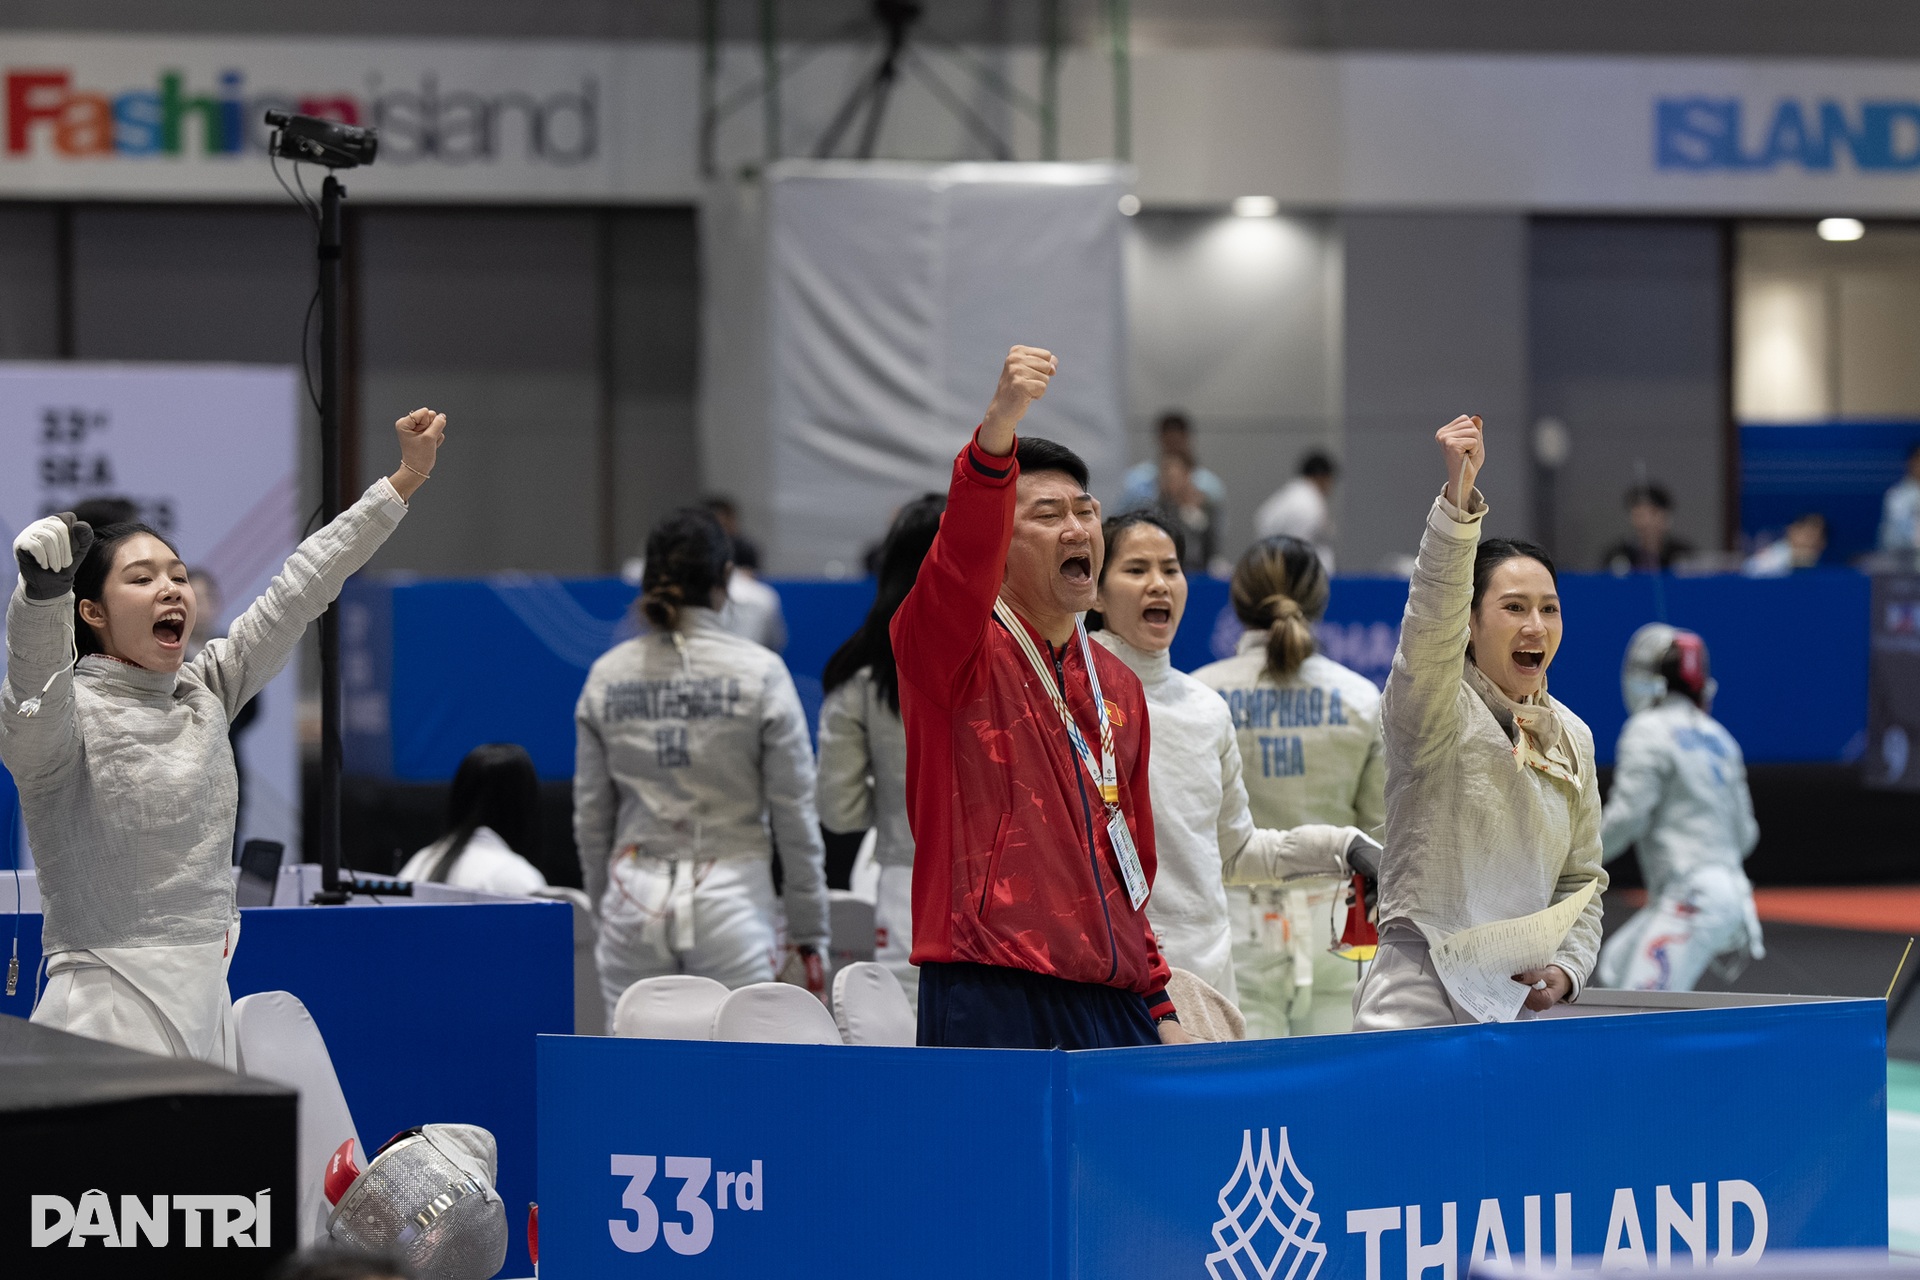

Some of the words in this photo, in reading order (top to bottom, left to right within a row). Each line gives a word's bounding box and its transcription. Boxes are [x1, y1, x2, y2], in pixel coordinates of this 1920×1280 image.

[1655, 97, 1920, 171] ISLAND
[1258, 735, 1306, 779] THA
[608, 1153, 764, 1256] 33rd
[1345, 1178, 1769, 1280] THAILAND
